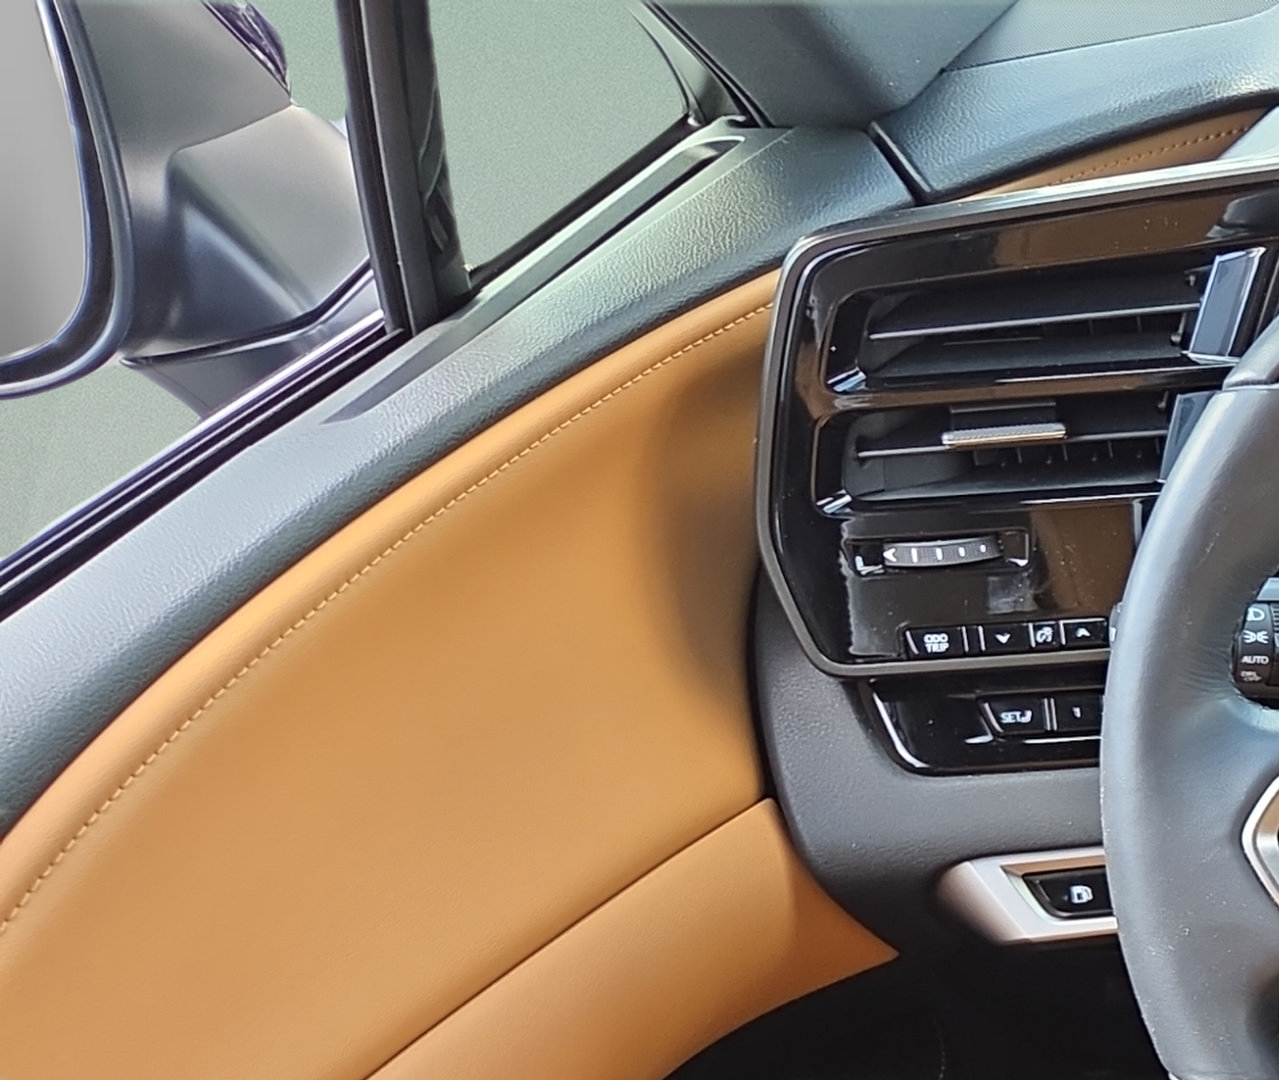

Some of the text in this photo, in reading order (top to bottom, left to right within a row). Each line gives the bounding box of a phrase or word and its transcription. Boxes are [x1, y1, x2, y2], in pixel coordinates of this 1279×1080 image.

[923, 633, 949, 643] ODO
[925, 642, 949, 653] TRIP
[1241, 656, 1269, 665] AUTO
[1000, 711, 1022, 723] SET
